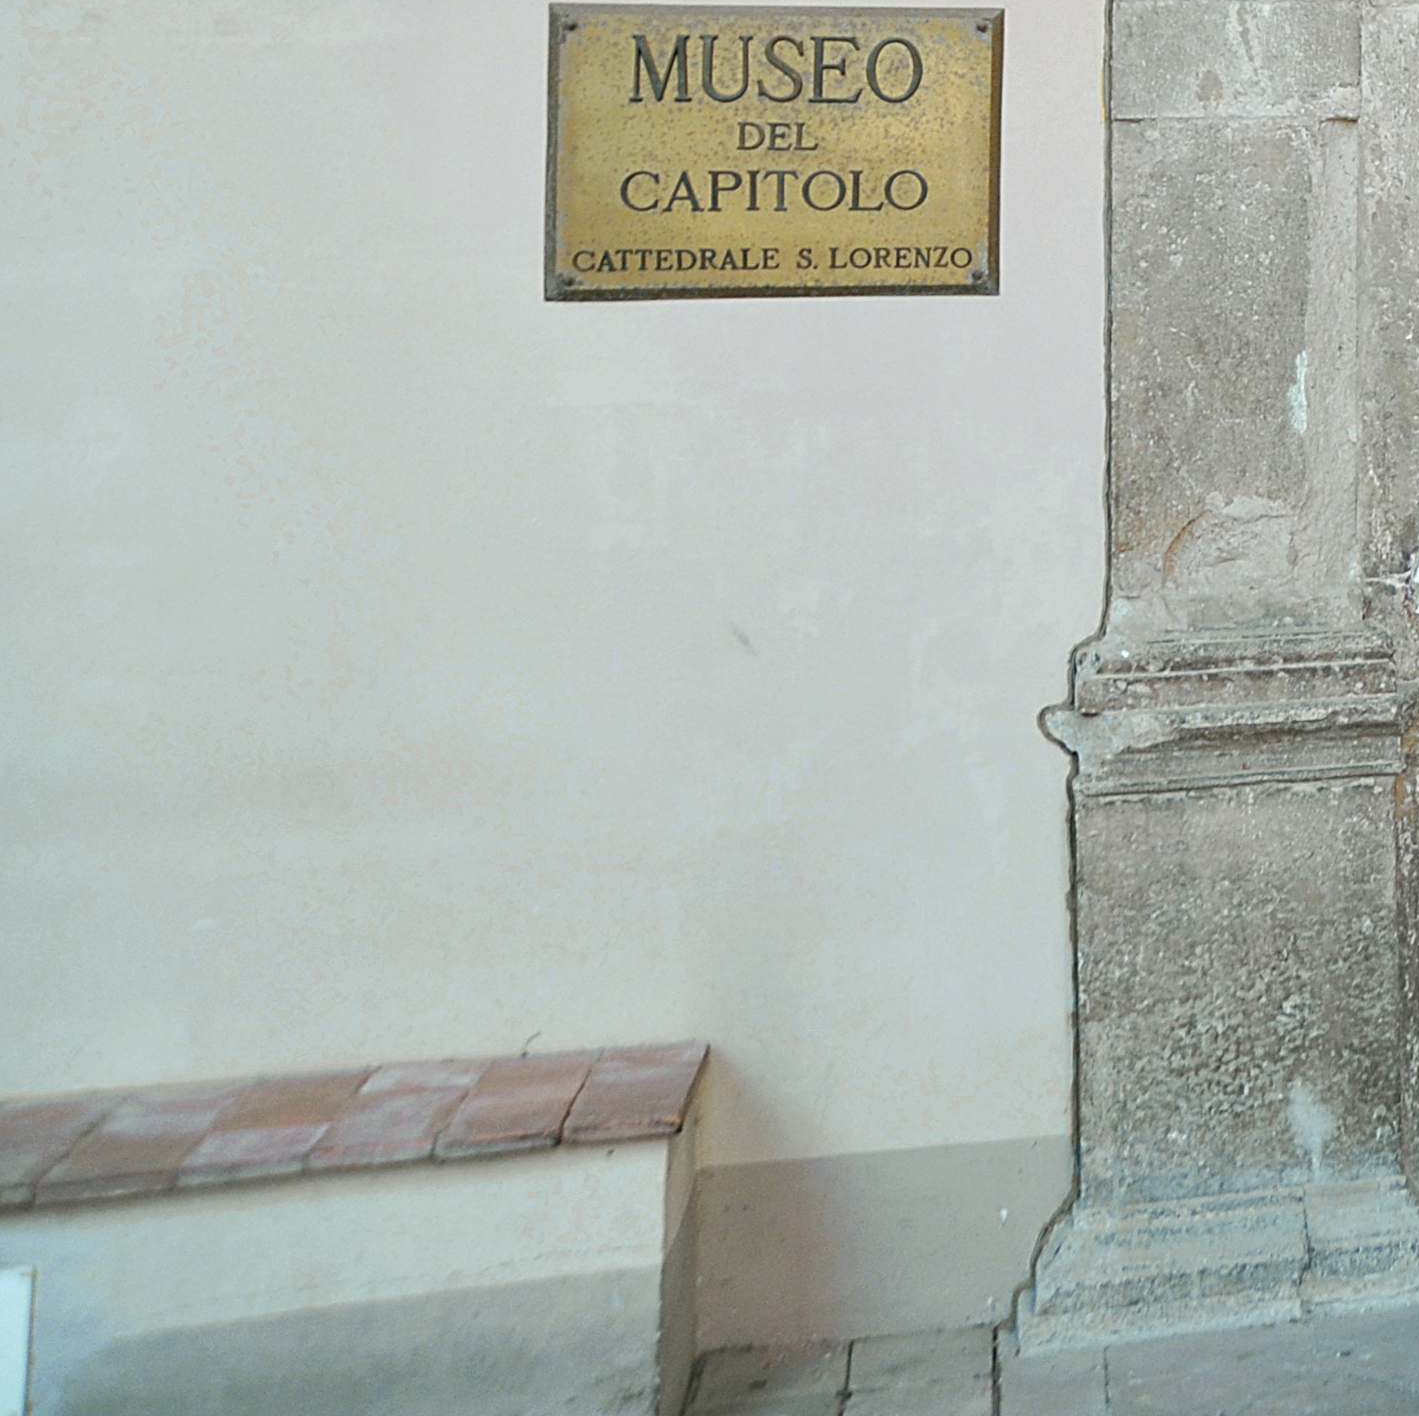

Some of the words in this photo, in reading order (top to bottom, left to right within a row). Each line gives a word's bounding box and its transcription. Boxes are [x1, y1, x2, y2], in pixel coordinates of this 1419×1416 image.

[628, 33, 924, 104] MUSEO
[736, 121, 819, 151] DEL
[620, 169, 929, 213] CAPITOLO
[572, 248, 780, 273] CATTEDRALE
[795, 247, 819, 270] S.
[829, 246, 973, 270] LORENZO
